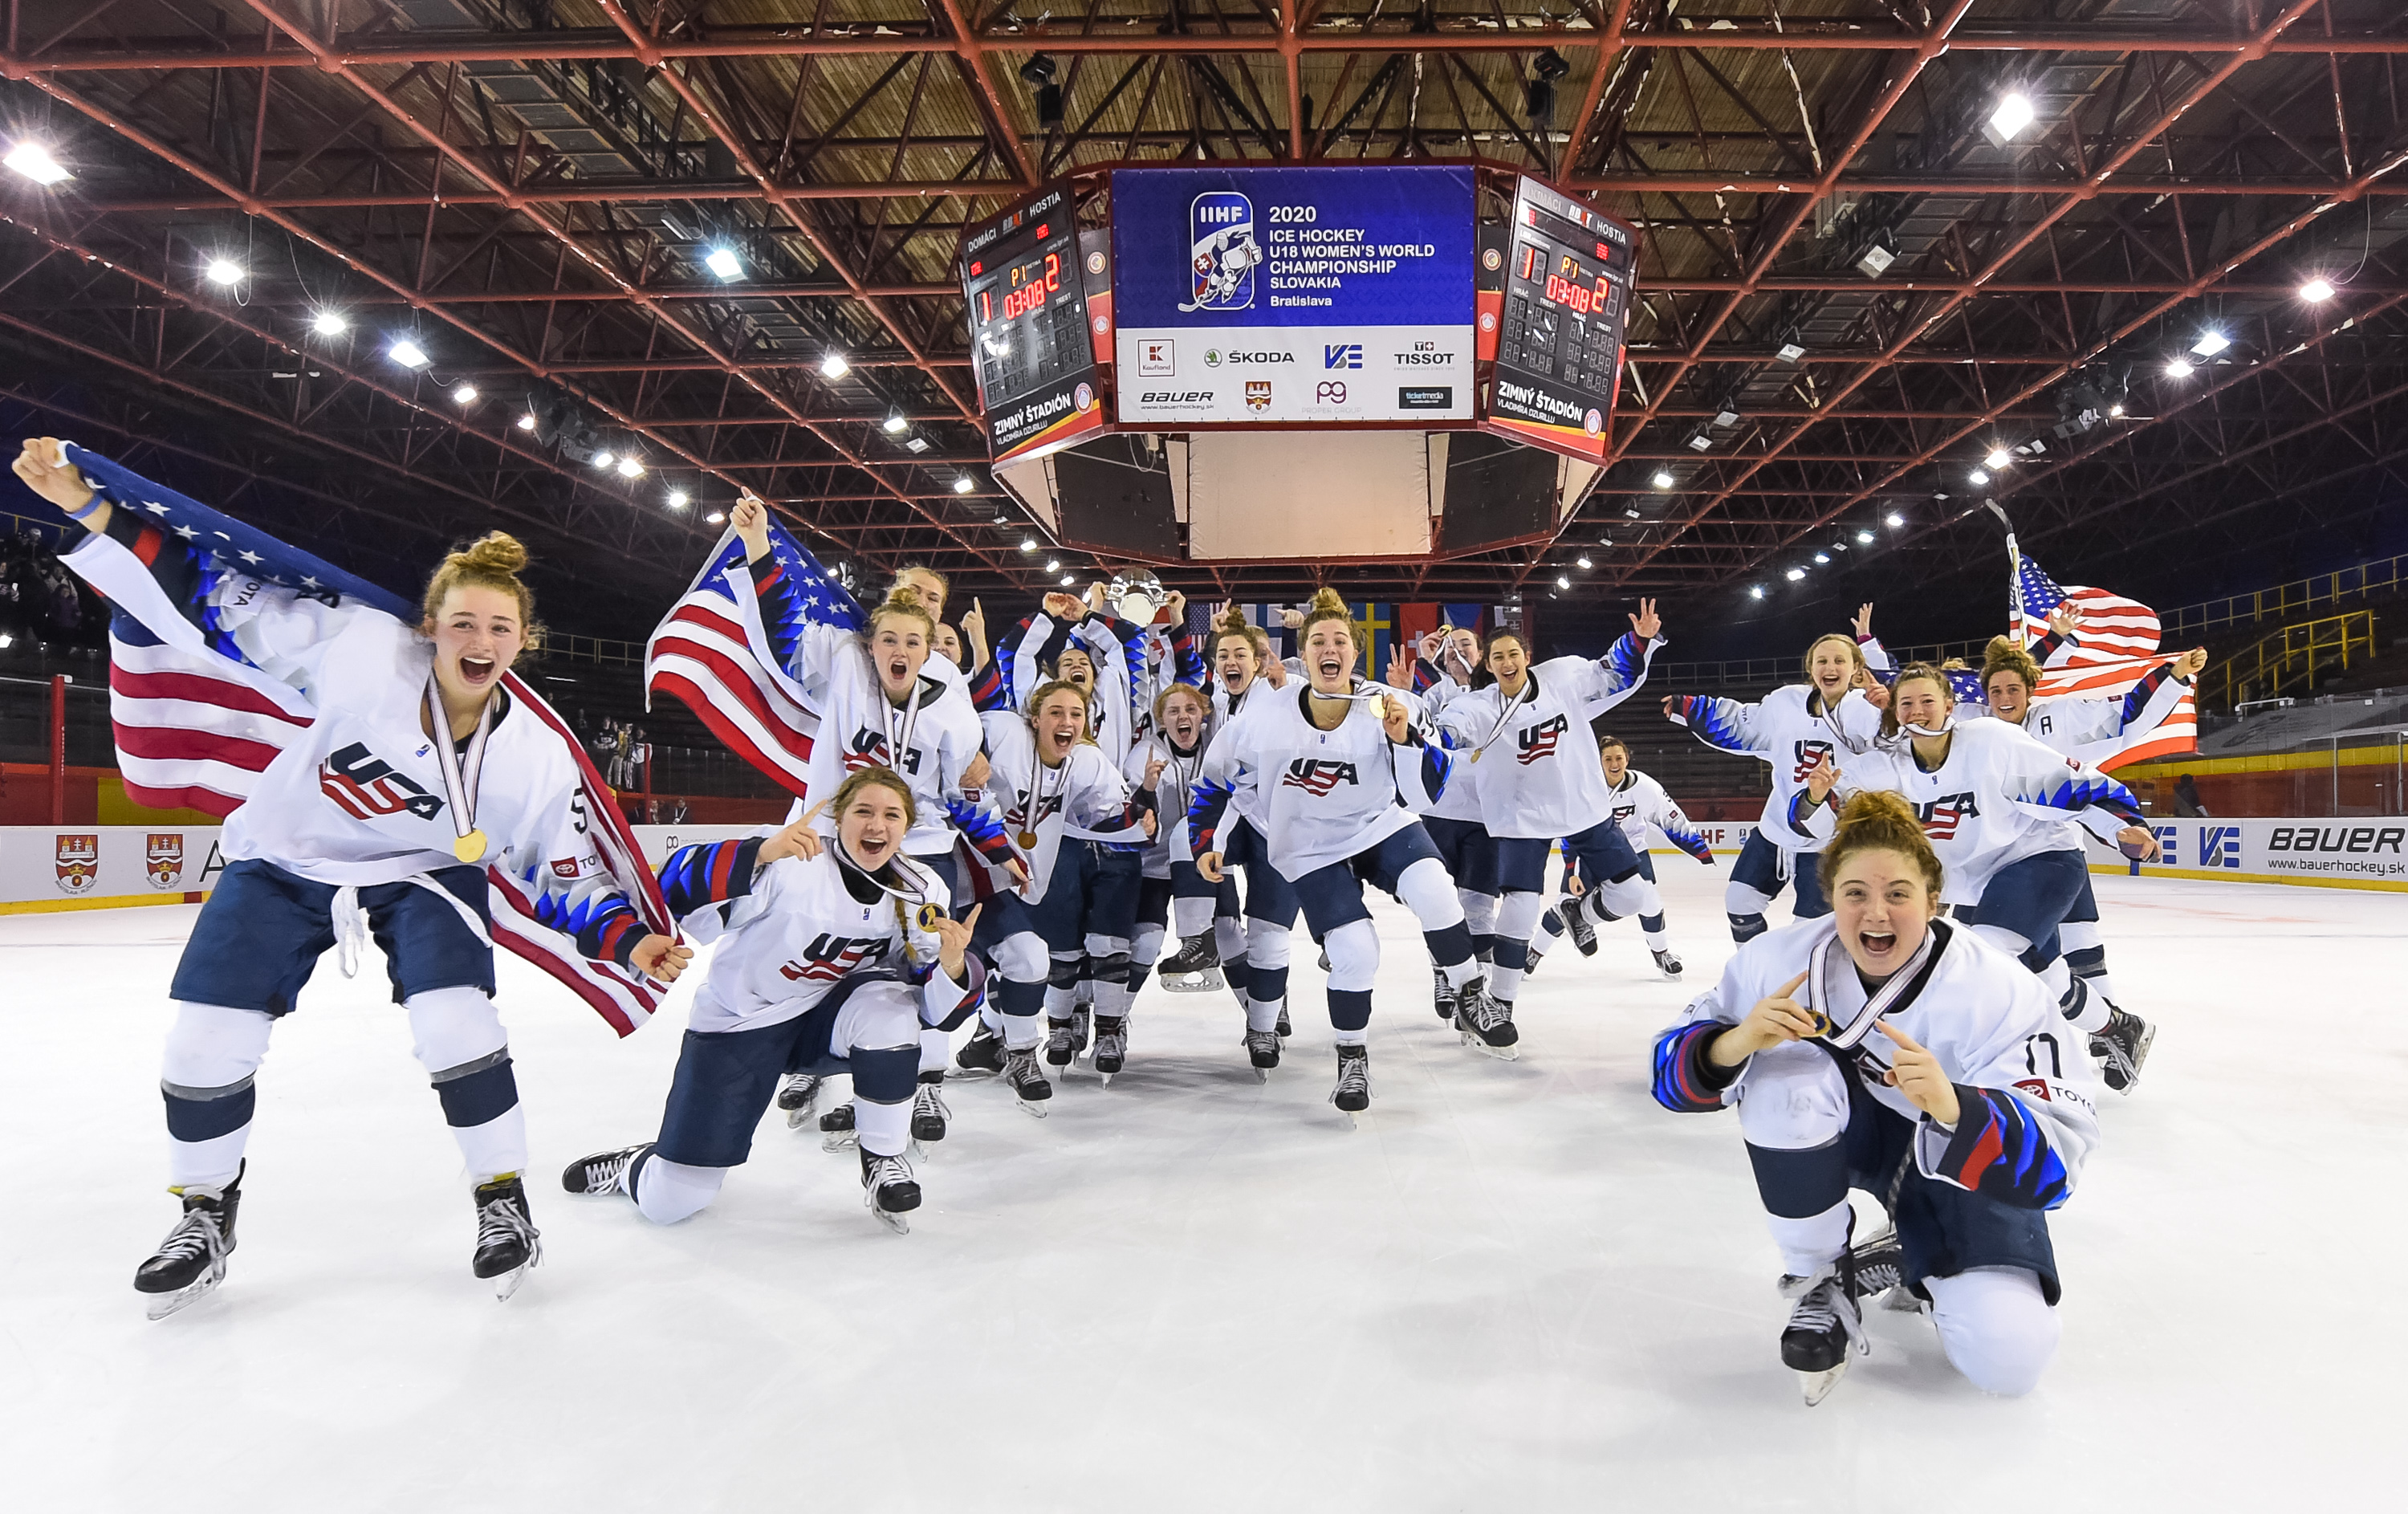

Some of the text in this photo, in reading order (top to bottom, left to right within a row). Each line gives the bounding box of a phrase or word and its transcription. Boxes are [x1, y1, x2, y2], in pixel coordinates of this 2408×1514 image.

[1029, 191, 1061, 218] HOSTIA
[1200, 206, 1243, 223] IIHF
[1269, 206, 1316, 223] 2020
[968, 227, 997, 253] DOMÁCI
[1269, 229, 1365, 242] ICE HOCKEY
[1597, 220, 1626, 245] HOSTIA
[1269, 244, 1435, 258] U18 WOMEN'S WORLD
[1045, 253, 1060, 292] 2
[1269, 260, 1397, 274] CHAMPIONSHIP
[1270, 276, 1342, 289] SLOVAKIA
[1003, 279, 1046, 320] 03:08
[1271, 295, 1332, 307] Bratislava
[1591, 277, 1609, 314] 2
[1229, 350, 1295, 364] ŠKODA
[1393, 353, 1454, 364] TISSOT
[1498, 381, 1583, 421] ZIMNÝ ŠTADIÓN
[995, 393, 1072, 435] ZIMNÝ ŠTADIÓN
[2040, 715, 2052, 736] A
[1517, 713, 1568, 766] USA
[319, 741, 447, 820] USA
[1283, 758, 1360, 797] USA
[1696, 829, 1725, 845] HF
[2268, 828, 2406, 854] BAUER
[2268, 858, 2406, 877] www.bauerhockey.sk
[787, 932, 893, 980] USA
